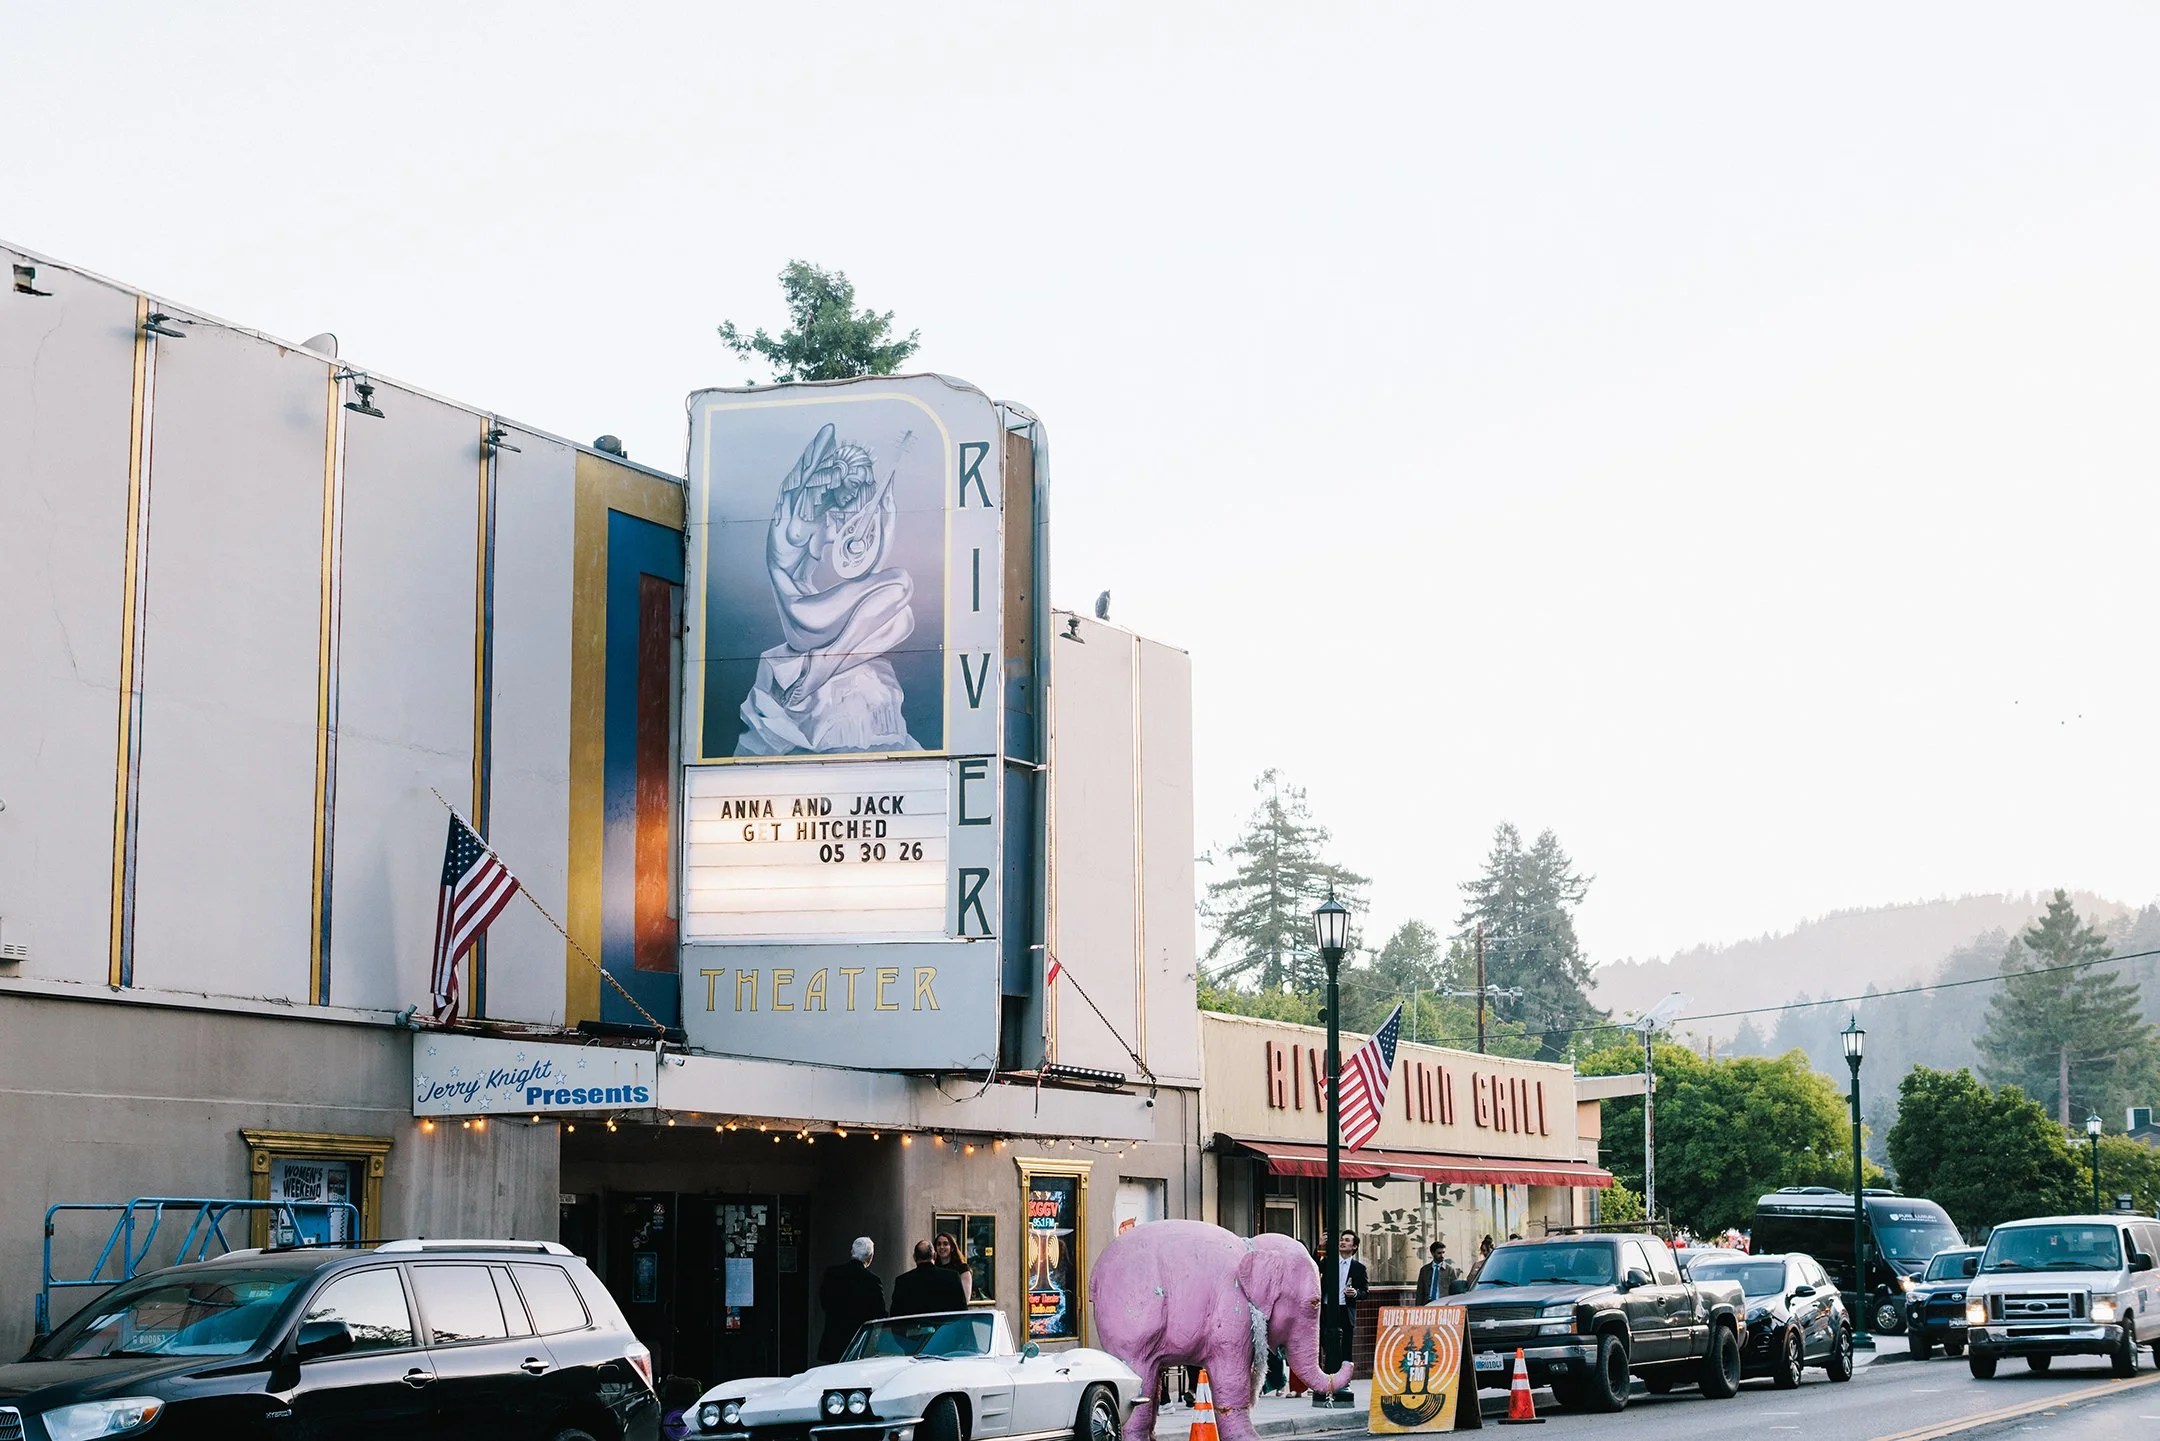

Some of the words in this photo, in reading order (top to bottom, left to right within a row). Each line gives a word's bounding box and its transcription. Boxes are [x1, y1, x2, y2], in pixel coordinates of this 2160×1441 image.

[957, 440, 994, 936] RIVER
[720, 799, 775, 819] ANNA
[792, 797, 832, 817] AND
[850, 795, 905, 816] JACK
[743, 822, 781, 841] GET
[796, 819, 888, 841] HITCHED
[819, 843, 845, 863] 05
[860, 842, 887, 863] 30
[899, 841, 923, 861] 26
[700, 966, 941, 1012] THEATER
[418, 1079, 482, 1103] Jerry
[485, 1059, 553, 1092] Knight
[526, 1084, 649, 1106] Presents
[1404, 1059, 1455, 1125] INN
[1473, 1071, 1554, 1137] GRILL
[284, 1165, 323, 1184] WOMEN'S
[283, 1178, 321, 1198] WEEKEND
[1383, 1309, 1404, 1327] RIVER
[1406, 1309, 1437, 1326] THEATER
[1438, 1308, 1461, 1326] RADIO
[1407, 1350, 1429, 1366] 95.1
[1409, 1366, 1426, 1382] FM
